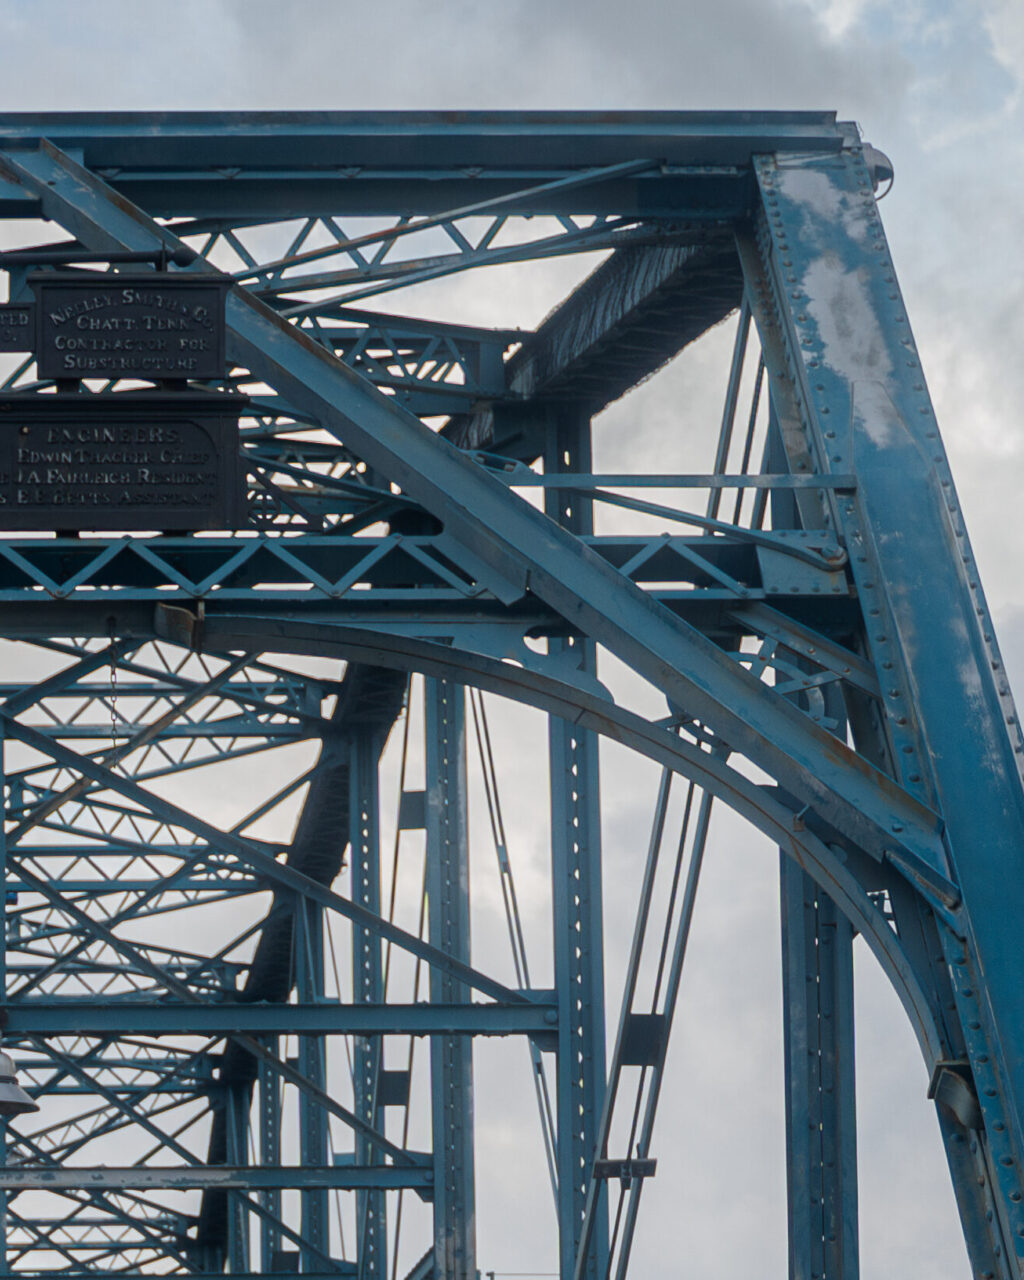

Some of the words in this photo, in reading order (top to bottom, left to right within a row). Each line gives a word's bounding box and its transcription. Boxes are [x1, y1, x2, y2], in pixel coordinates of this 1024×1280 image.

[122, 289, 178, 312] SMITH
[54, 335, 166, 351] CONTRACTOR
[177, 338, 210, 351] FOR
[63, 354, 198, 370] SUBSTRUCTURE
[17, 448, 72, 464] EDWIN
